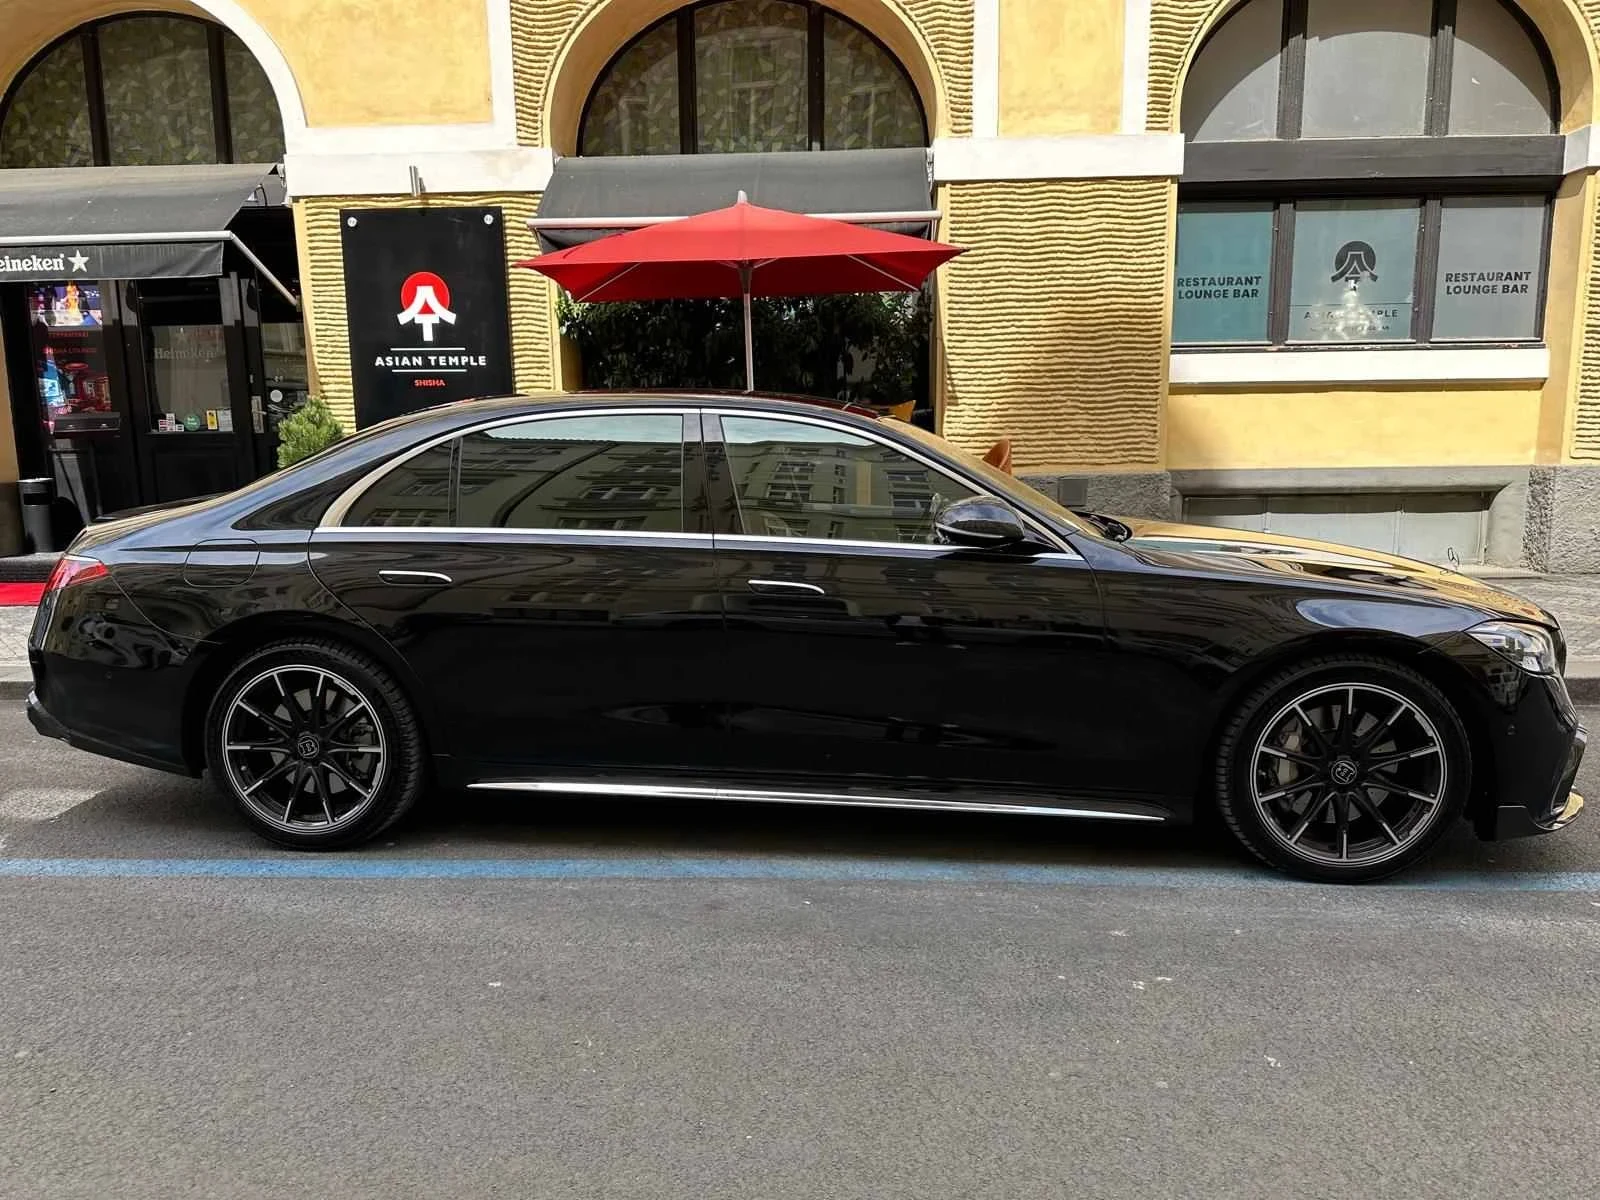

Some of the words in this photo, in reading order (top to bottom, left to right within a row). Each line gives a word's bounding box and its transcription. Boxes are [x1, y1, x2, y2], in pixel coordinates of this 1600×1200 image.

[1177, 276, 1262, 287] RESTAURANT
[1445, 271, 1532, 282] RESTAURANT
[1178, 289, 1229, 300] LOUNGE
[1232, 288, 1259, 298] BAR
[1446, 284, 1498, 295] LOUNGE
[1502, 284, 1529, 294] BAR
[375, 356, 423, 367] ASIAN
[427, 355, 488, 366] TEMPLE
[414, 379, 446, 387] SHISHA
